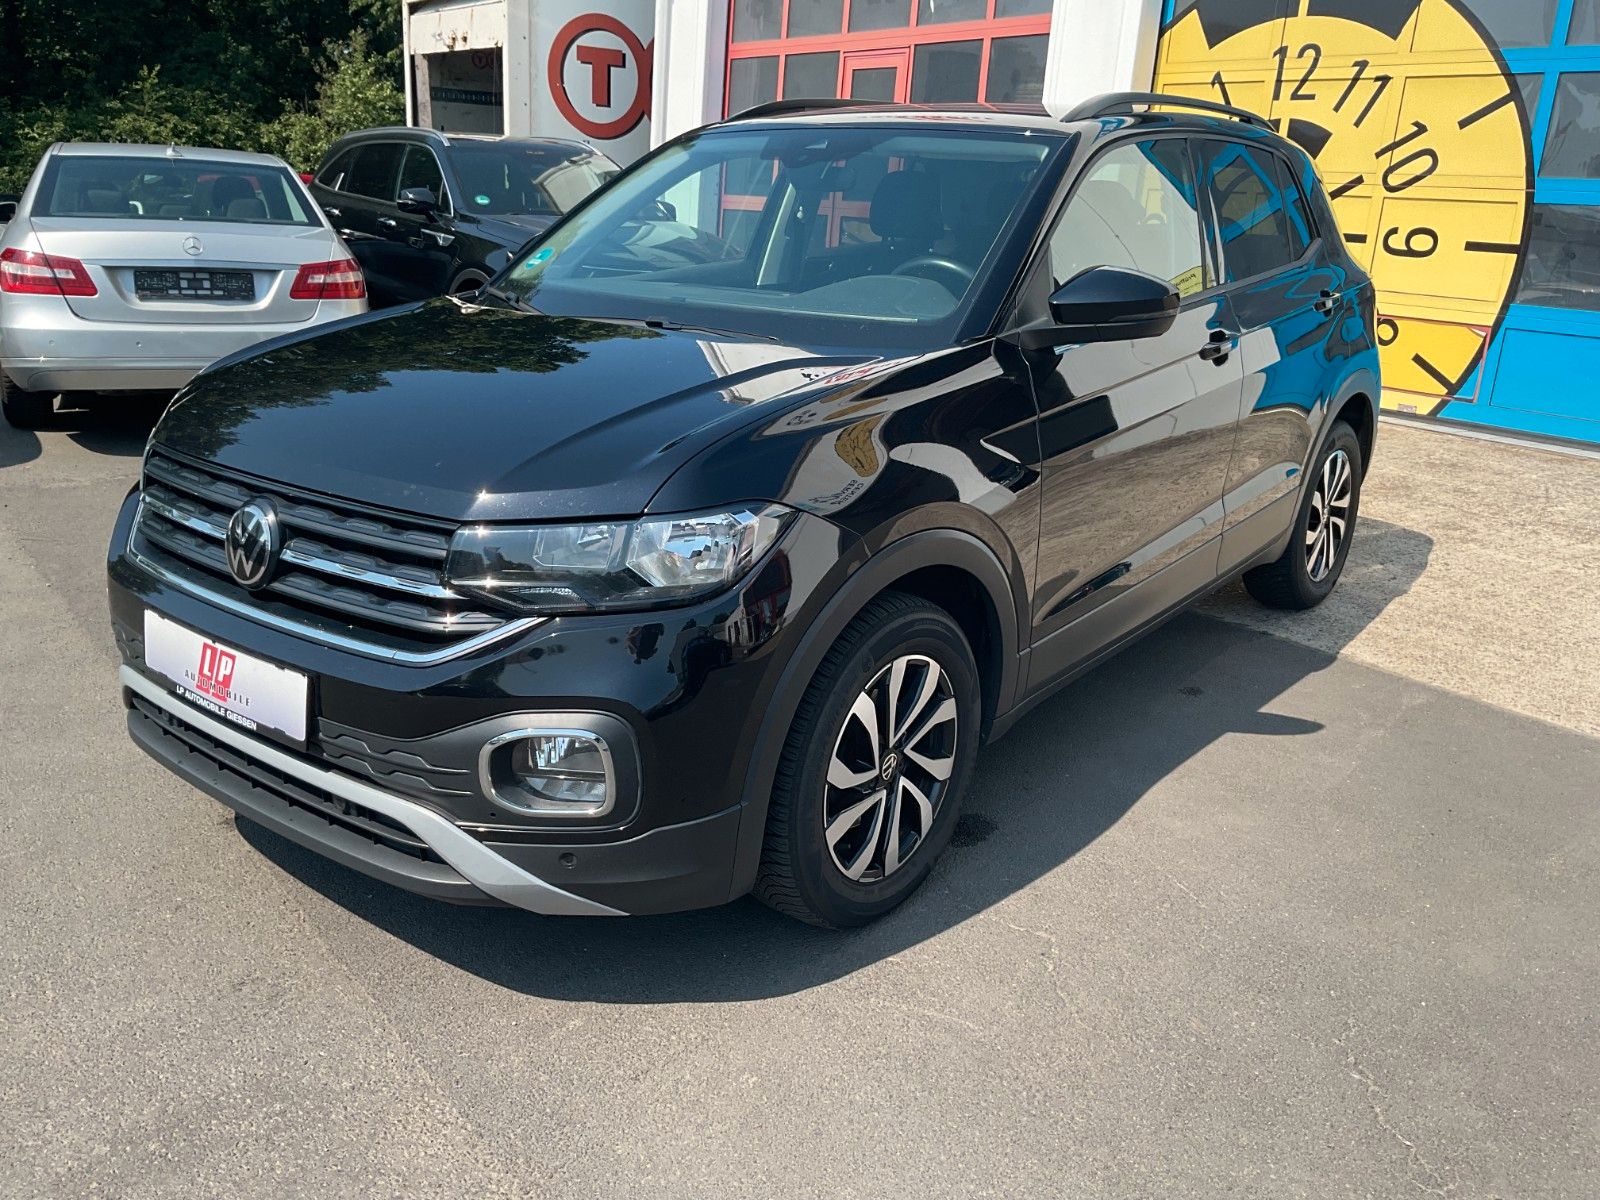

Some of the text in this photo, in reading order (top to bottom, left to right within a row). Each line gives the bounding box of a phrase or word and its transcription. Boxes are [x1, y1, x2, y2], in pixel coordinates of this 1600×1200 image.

[576, 44, 626, 107] T
[1272, 43, 1322, 101] 12
[1333, 59, 1393, 128] 11
[1374, 120, 1439, 193] 10
[184, 669, 251, 707] AUTOMOBILE
[202, 647, 234, 683] LP
[176, 684, 257, 731] LP AUTOMOBILE GIESSEN
